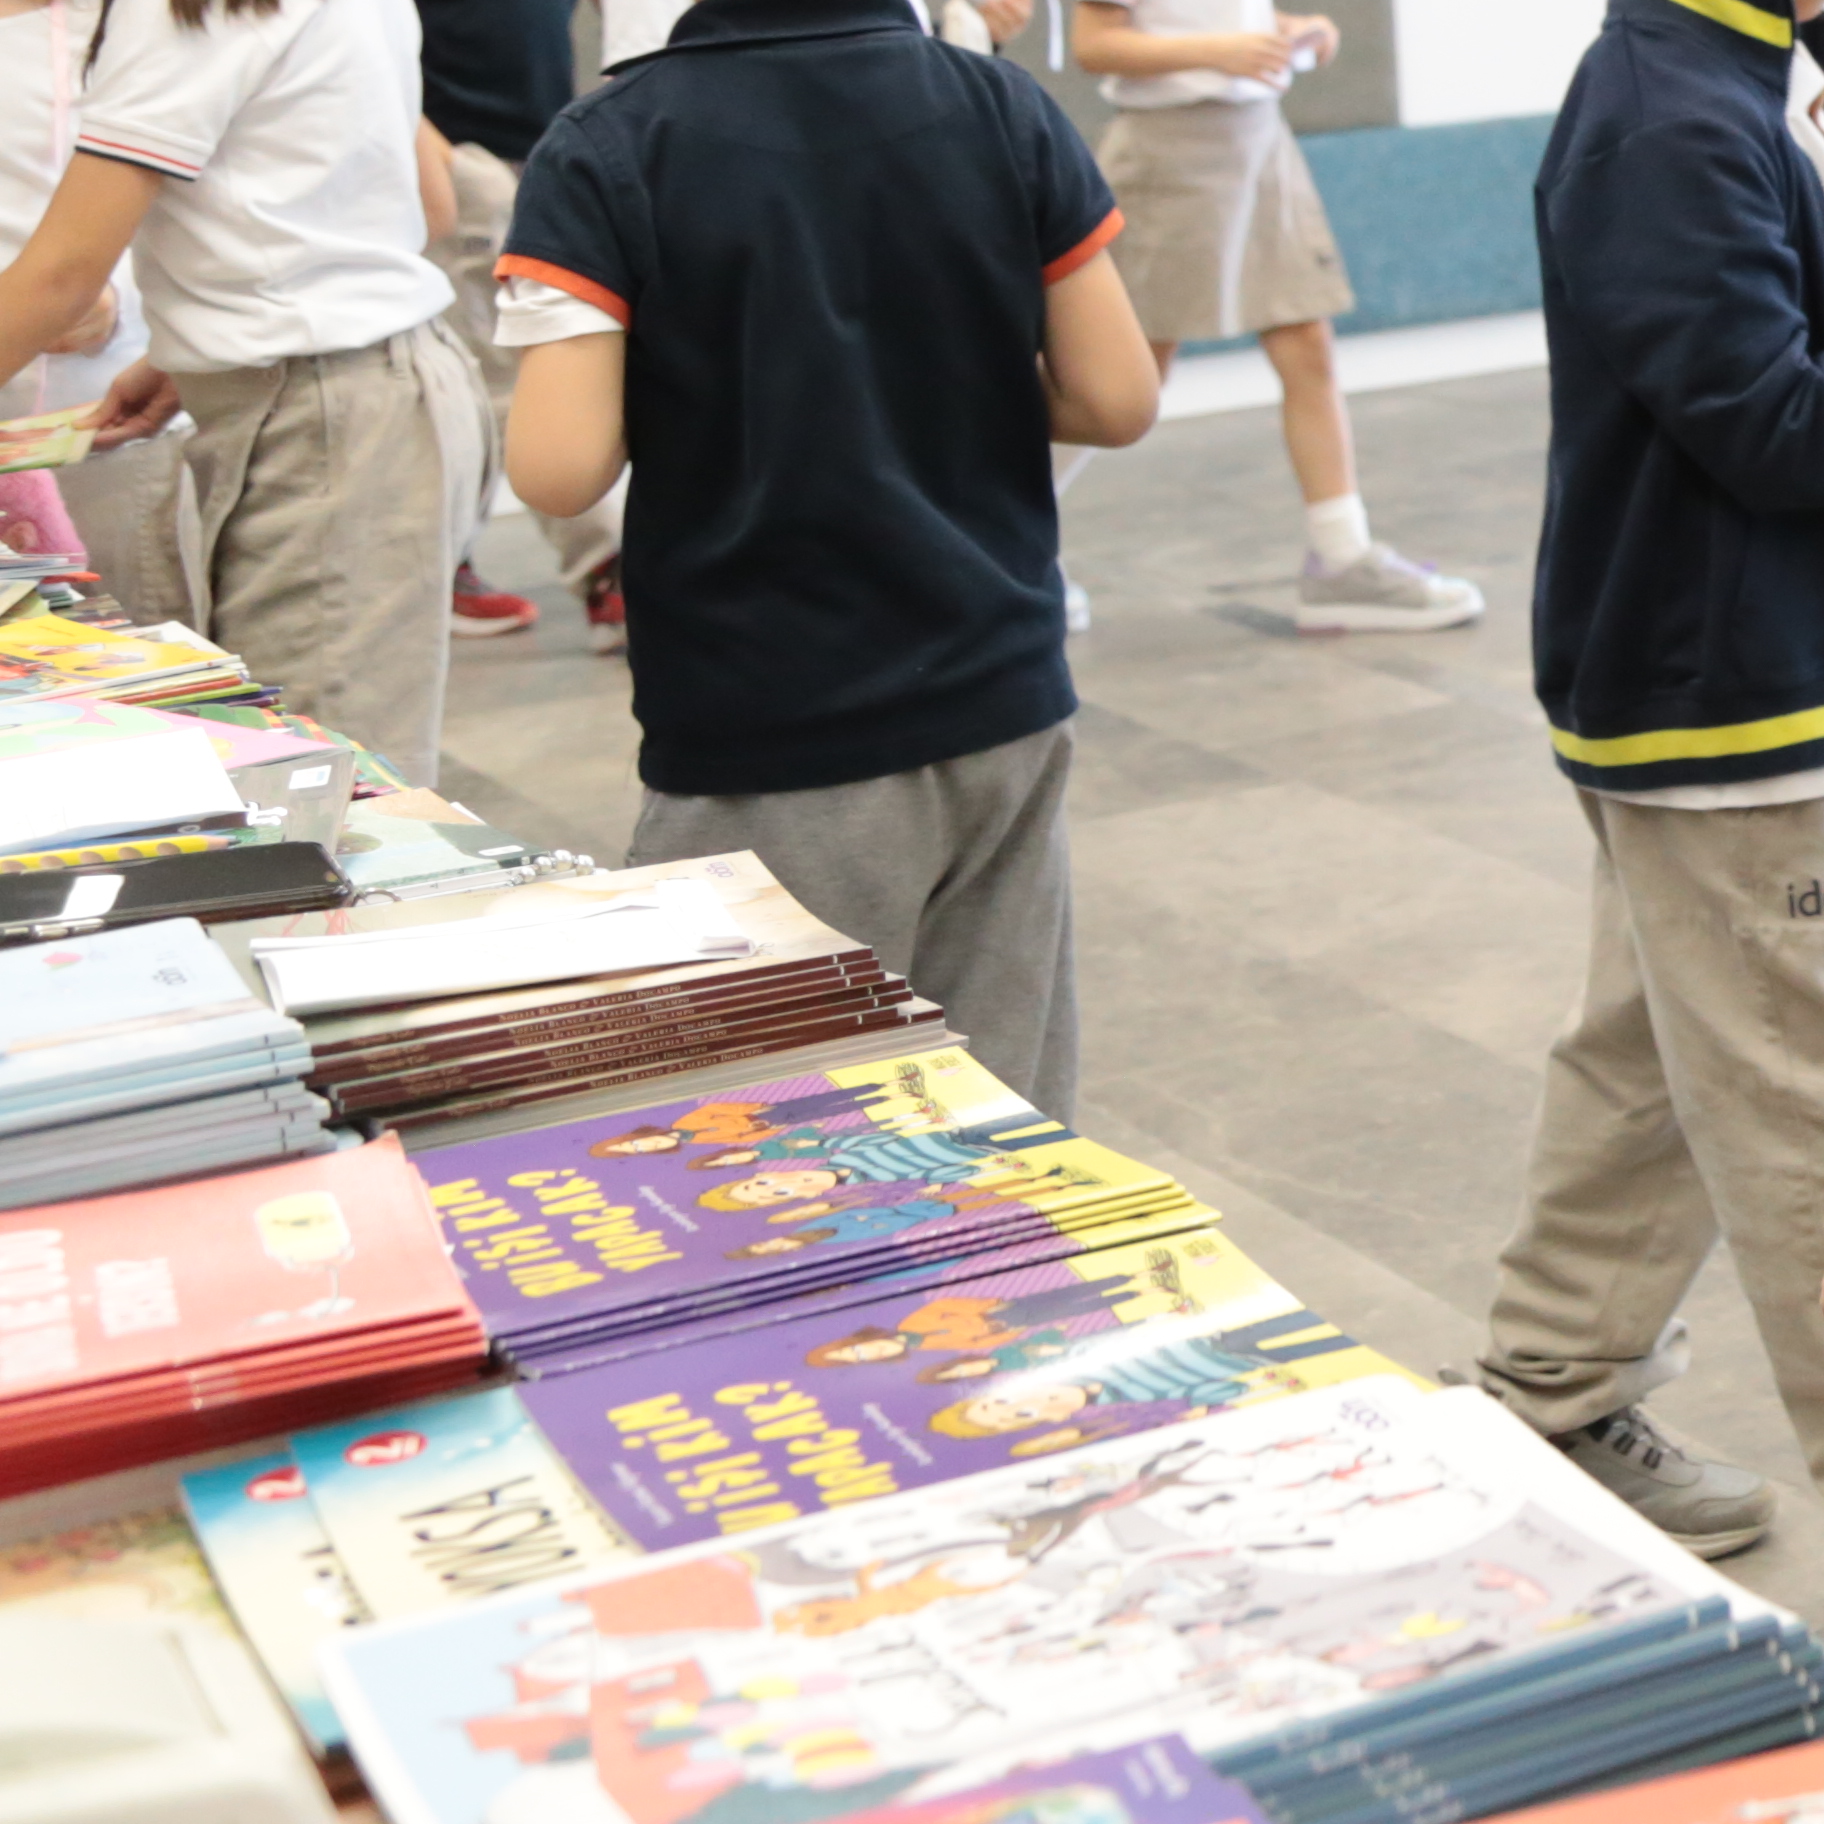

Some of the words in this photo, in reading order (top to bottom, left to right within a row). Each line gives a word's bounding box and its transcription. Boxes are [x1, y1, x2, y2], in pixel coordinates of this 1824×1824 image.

[539, 1003, 576, 1015] BLANCO
[593, 994, 633, 1005] VALERIA
[636, 985, 681, 998] DOCAMPO
[583, 1037, 619, 1050] BLANCO
[636, 1027, 674, 1039] VALERIA
[677, 1019, 721, 1032] DOCAMPO
[589, 1048, 625, 1061] BLANCO
[642, 1038, 680, 1050] VALERIA
[683, 1030, 727, 1043] DOCAMPO
[628, 1068, 663, 1080] BLANCO
[679, 1057, 717, 1069] VALERIA
[721, 1048, 763, 1061] DOCAMPO
[712, 1379, 900, 1511] APACAK?
